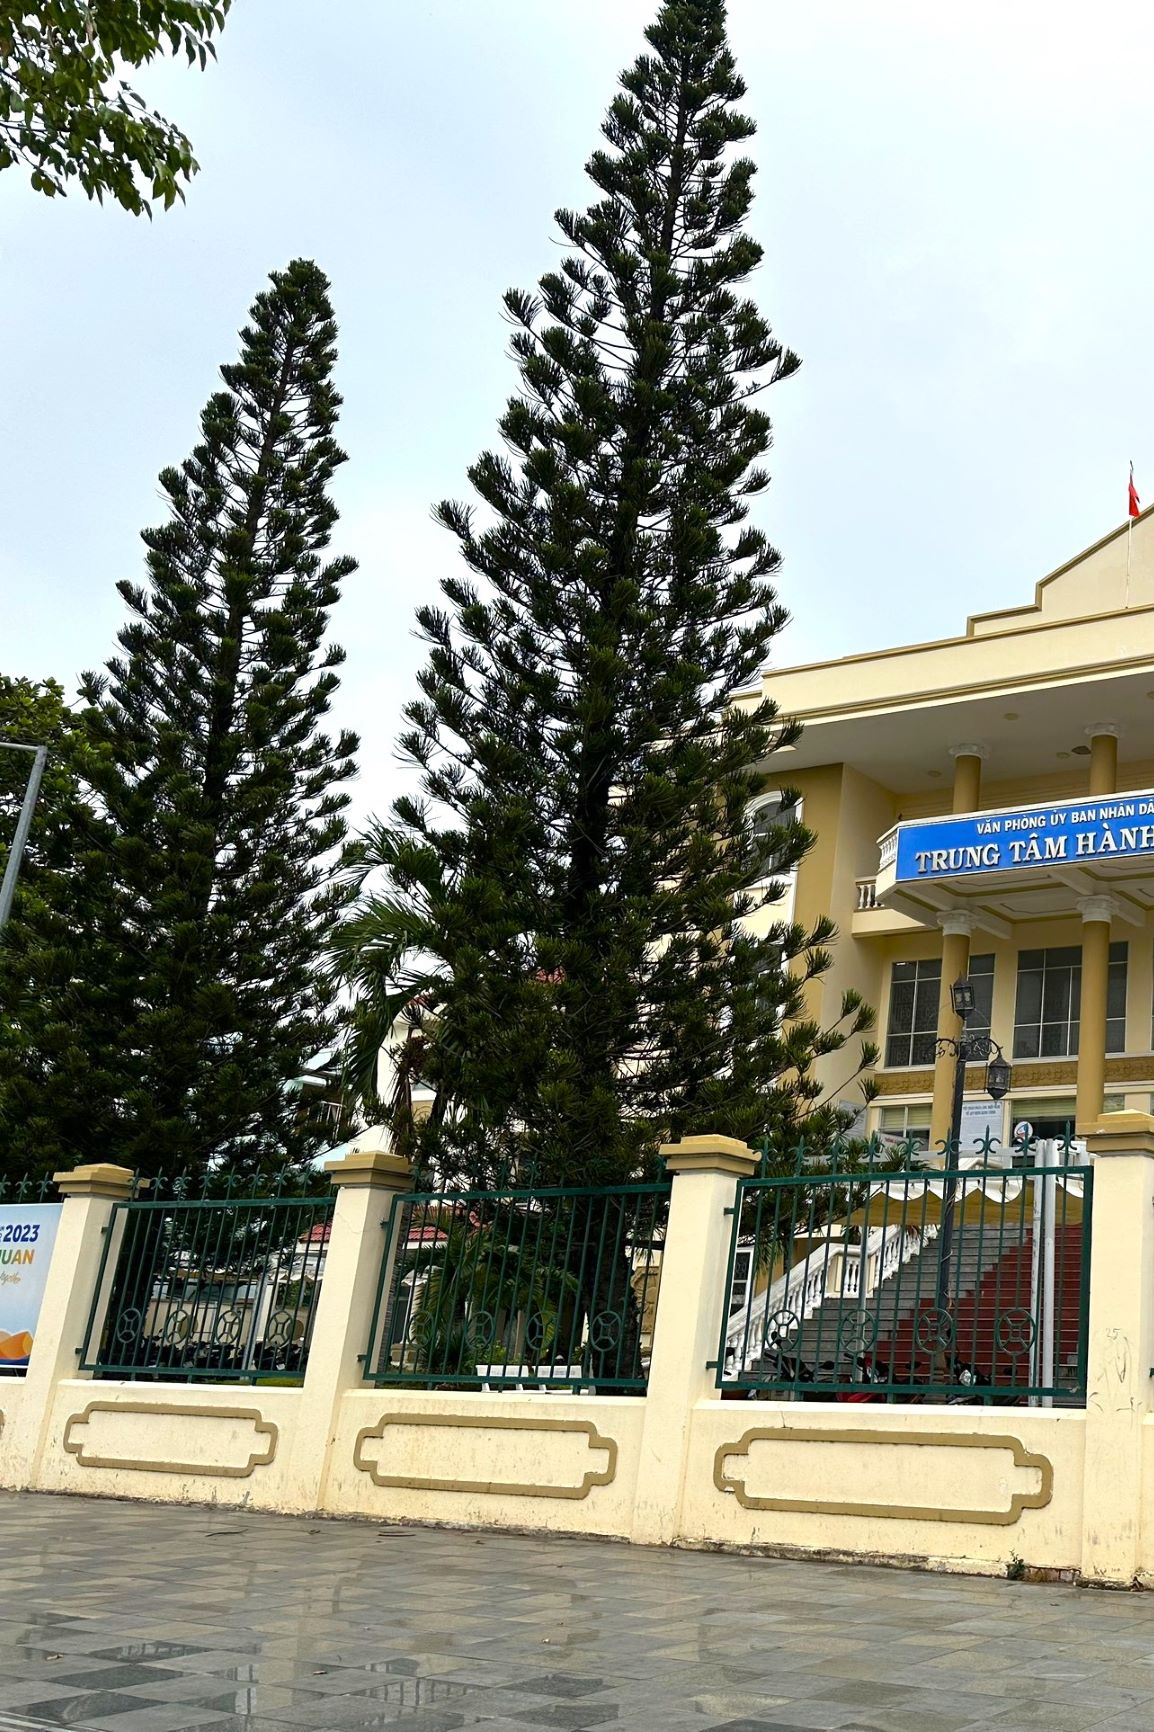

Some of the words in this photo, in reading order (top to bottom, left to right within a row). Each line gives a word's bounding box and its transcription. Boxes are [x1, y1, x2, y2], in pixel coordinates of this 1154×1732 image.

[977, 819, 1000, 834] VĂN
[1004, 815, 1046, 832] PHÒNG
[1071, 809, 1096, 823] BAN
[1100, 803, 1135, 819] NHÂN
[915, 843, 1000, 873] TRUNG
[1009, 833, 1067, 863] TÂM
[3, 1224, 41, 1243] 2023
